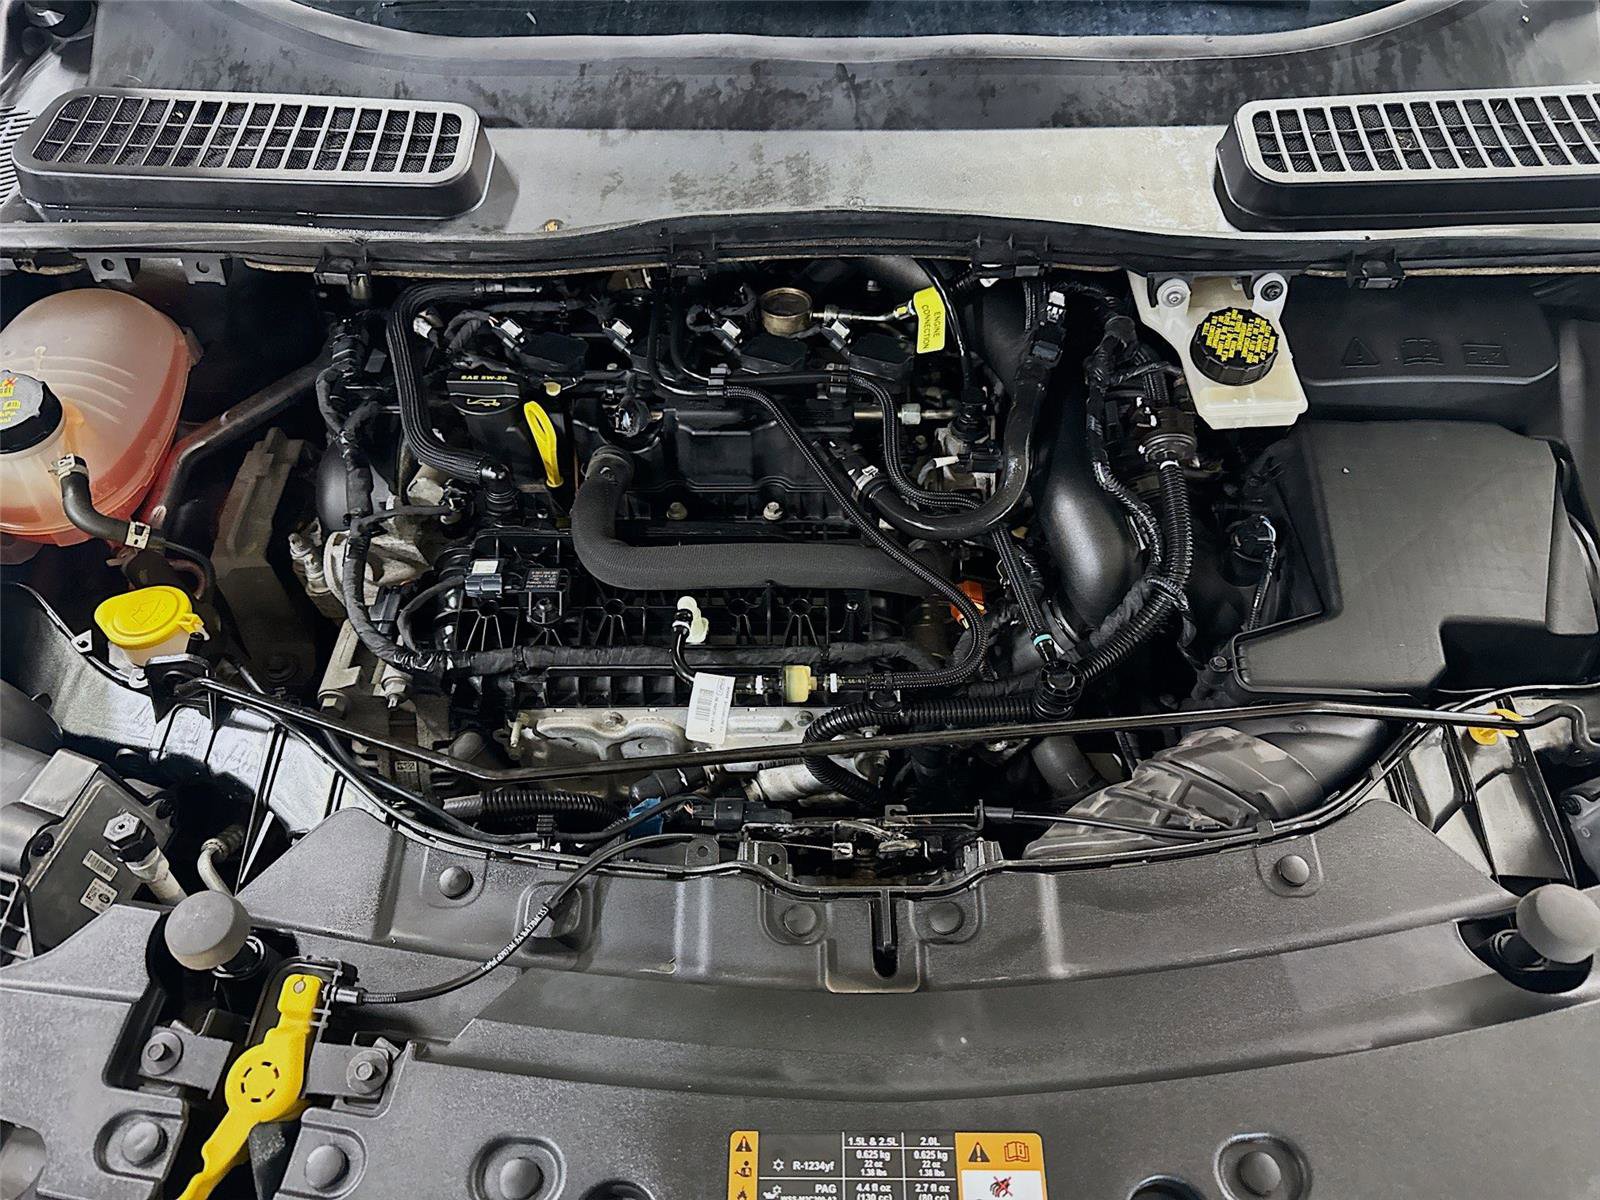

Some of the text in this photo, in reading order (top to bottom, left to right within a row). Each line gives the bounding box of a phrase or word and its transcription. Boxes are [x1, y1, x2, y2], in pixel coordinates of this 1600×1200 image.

[921, 304, 931, 350] CONNECTION
[933, 311, 941, 338] ENGINE
[848, 1137, 899, 1146] 1.5L & 2.5L
[920, 1137, 940, 1146] 2.0L
[856, 1150, 891, 1161] 0.625 kg
[913, 1150, 949, 1161] 0.625 kg
[792, 1161, 835, 1173] R-1234yf
[864, 1160, 873, 1168] 22
[922, 1160, 931, 1168] 22
[814, 1184, 837, 1194] PAG
[856, 1183, 871, 1192] 4.4
[880, 1184, 891, 1192] oz
[915, 1183, 929, 1192] 2.7
